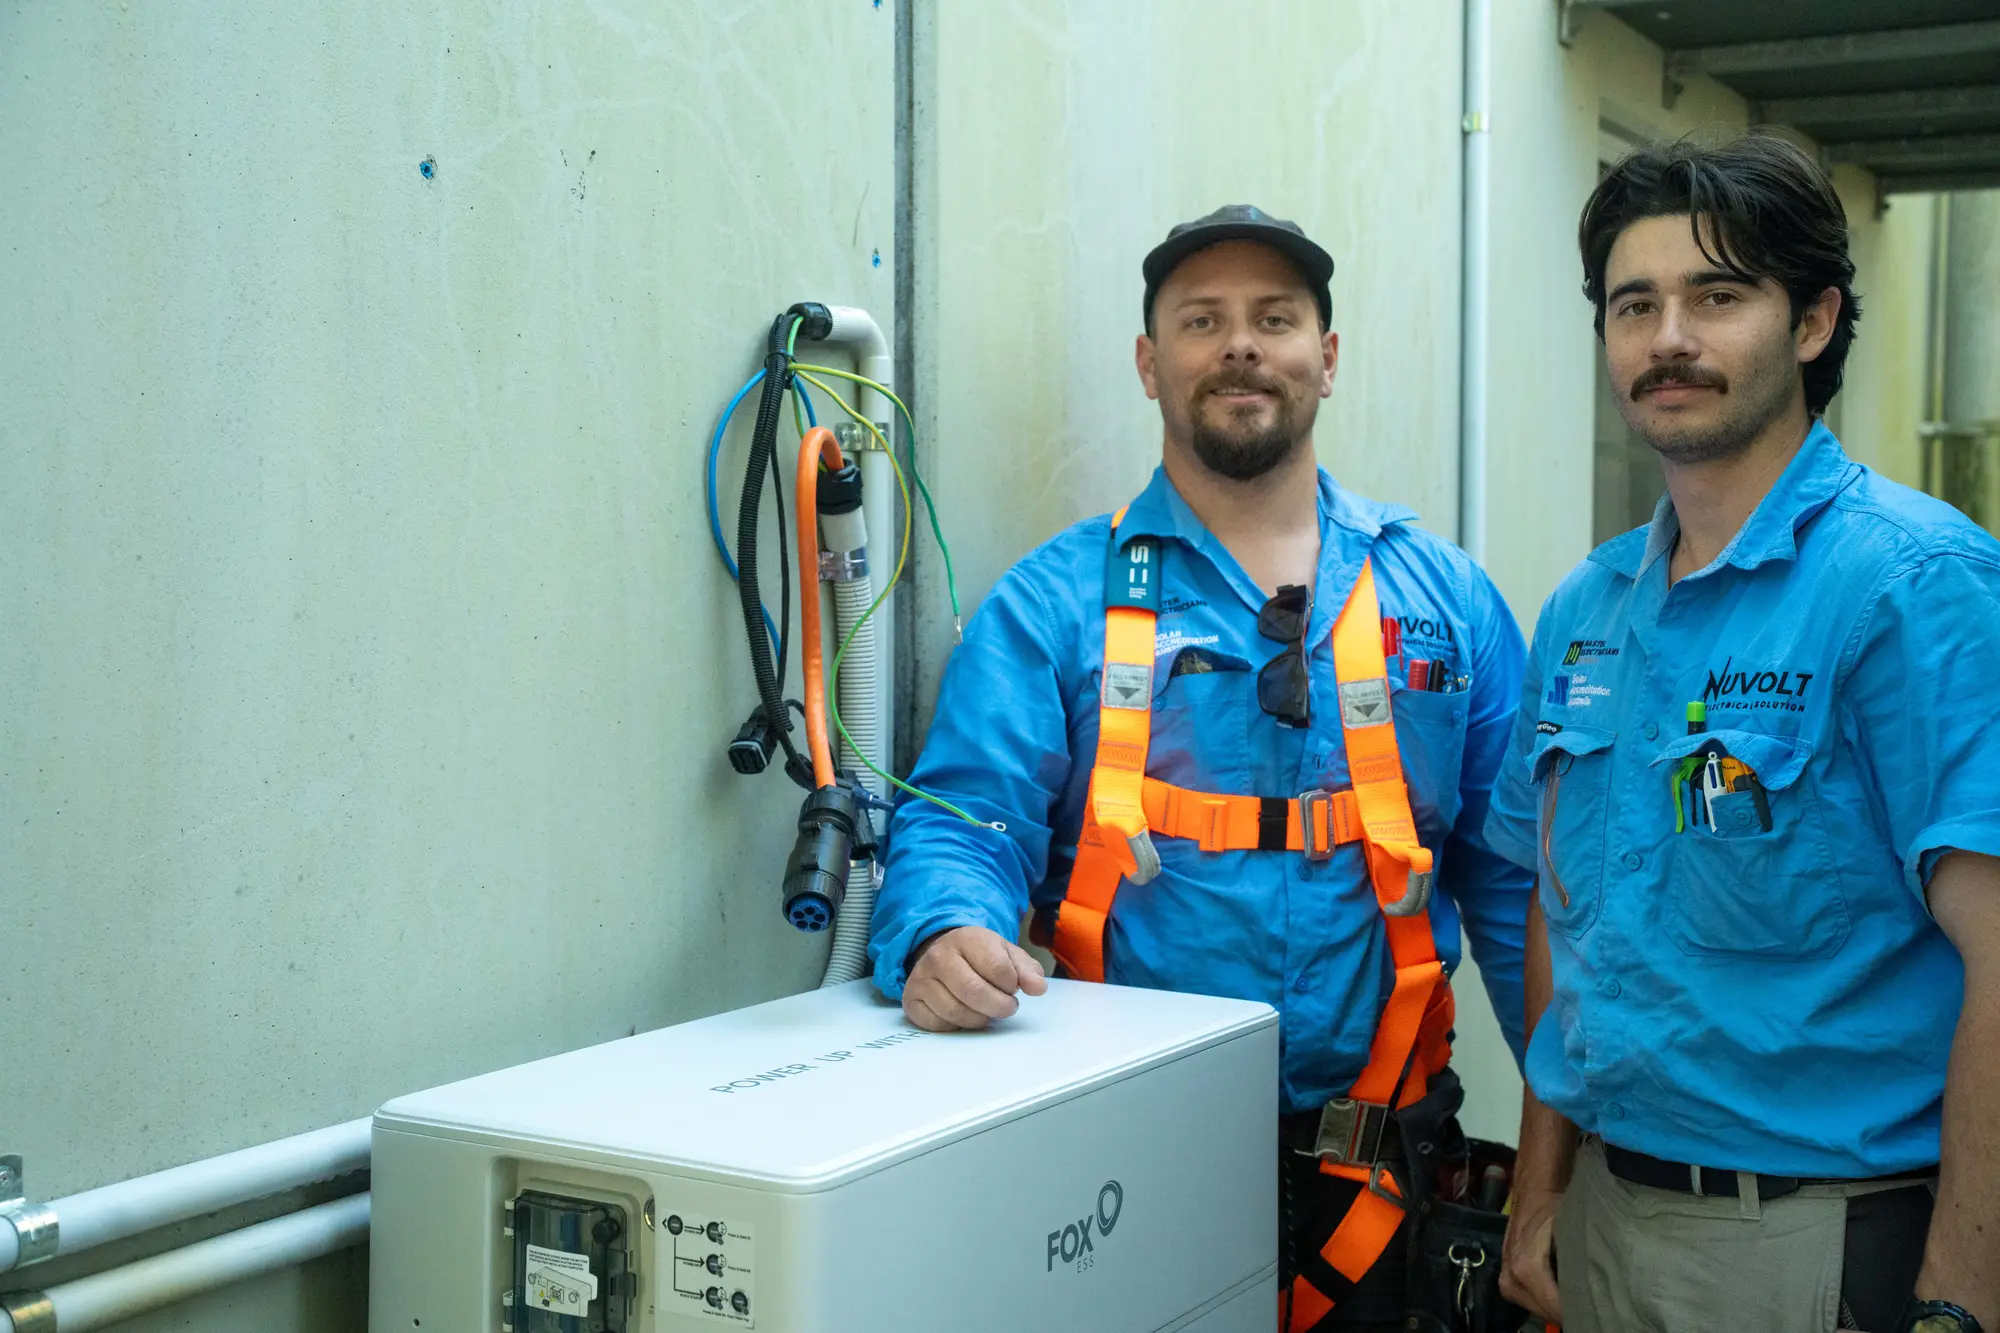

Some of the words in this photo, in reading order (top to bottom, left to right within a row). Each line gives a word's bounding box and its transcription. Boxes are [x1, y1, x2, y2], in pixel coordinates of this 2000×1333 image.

[1703, 656, 1813, 702] NUVOLT
[709, 1062, 818, 1094] POWER
[813, 1050, 855, 1062] UP
[1047, 1214, 1094, 1273] FOX
[1076, 1255, 1094, 1274] ESS
